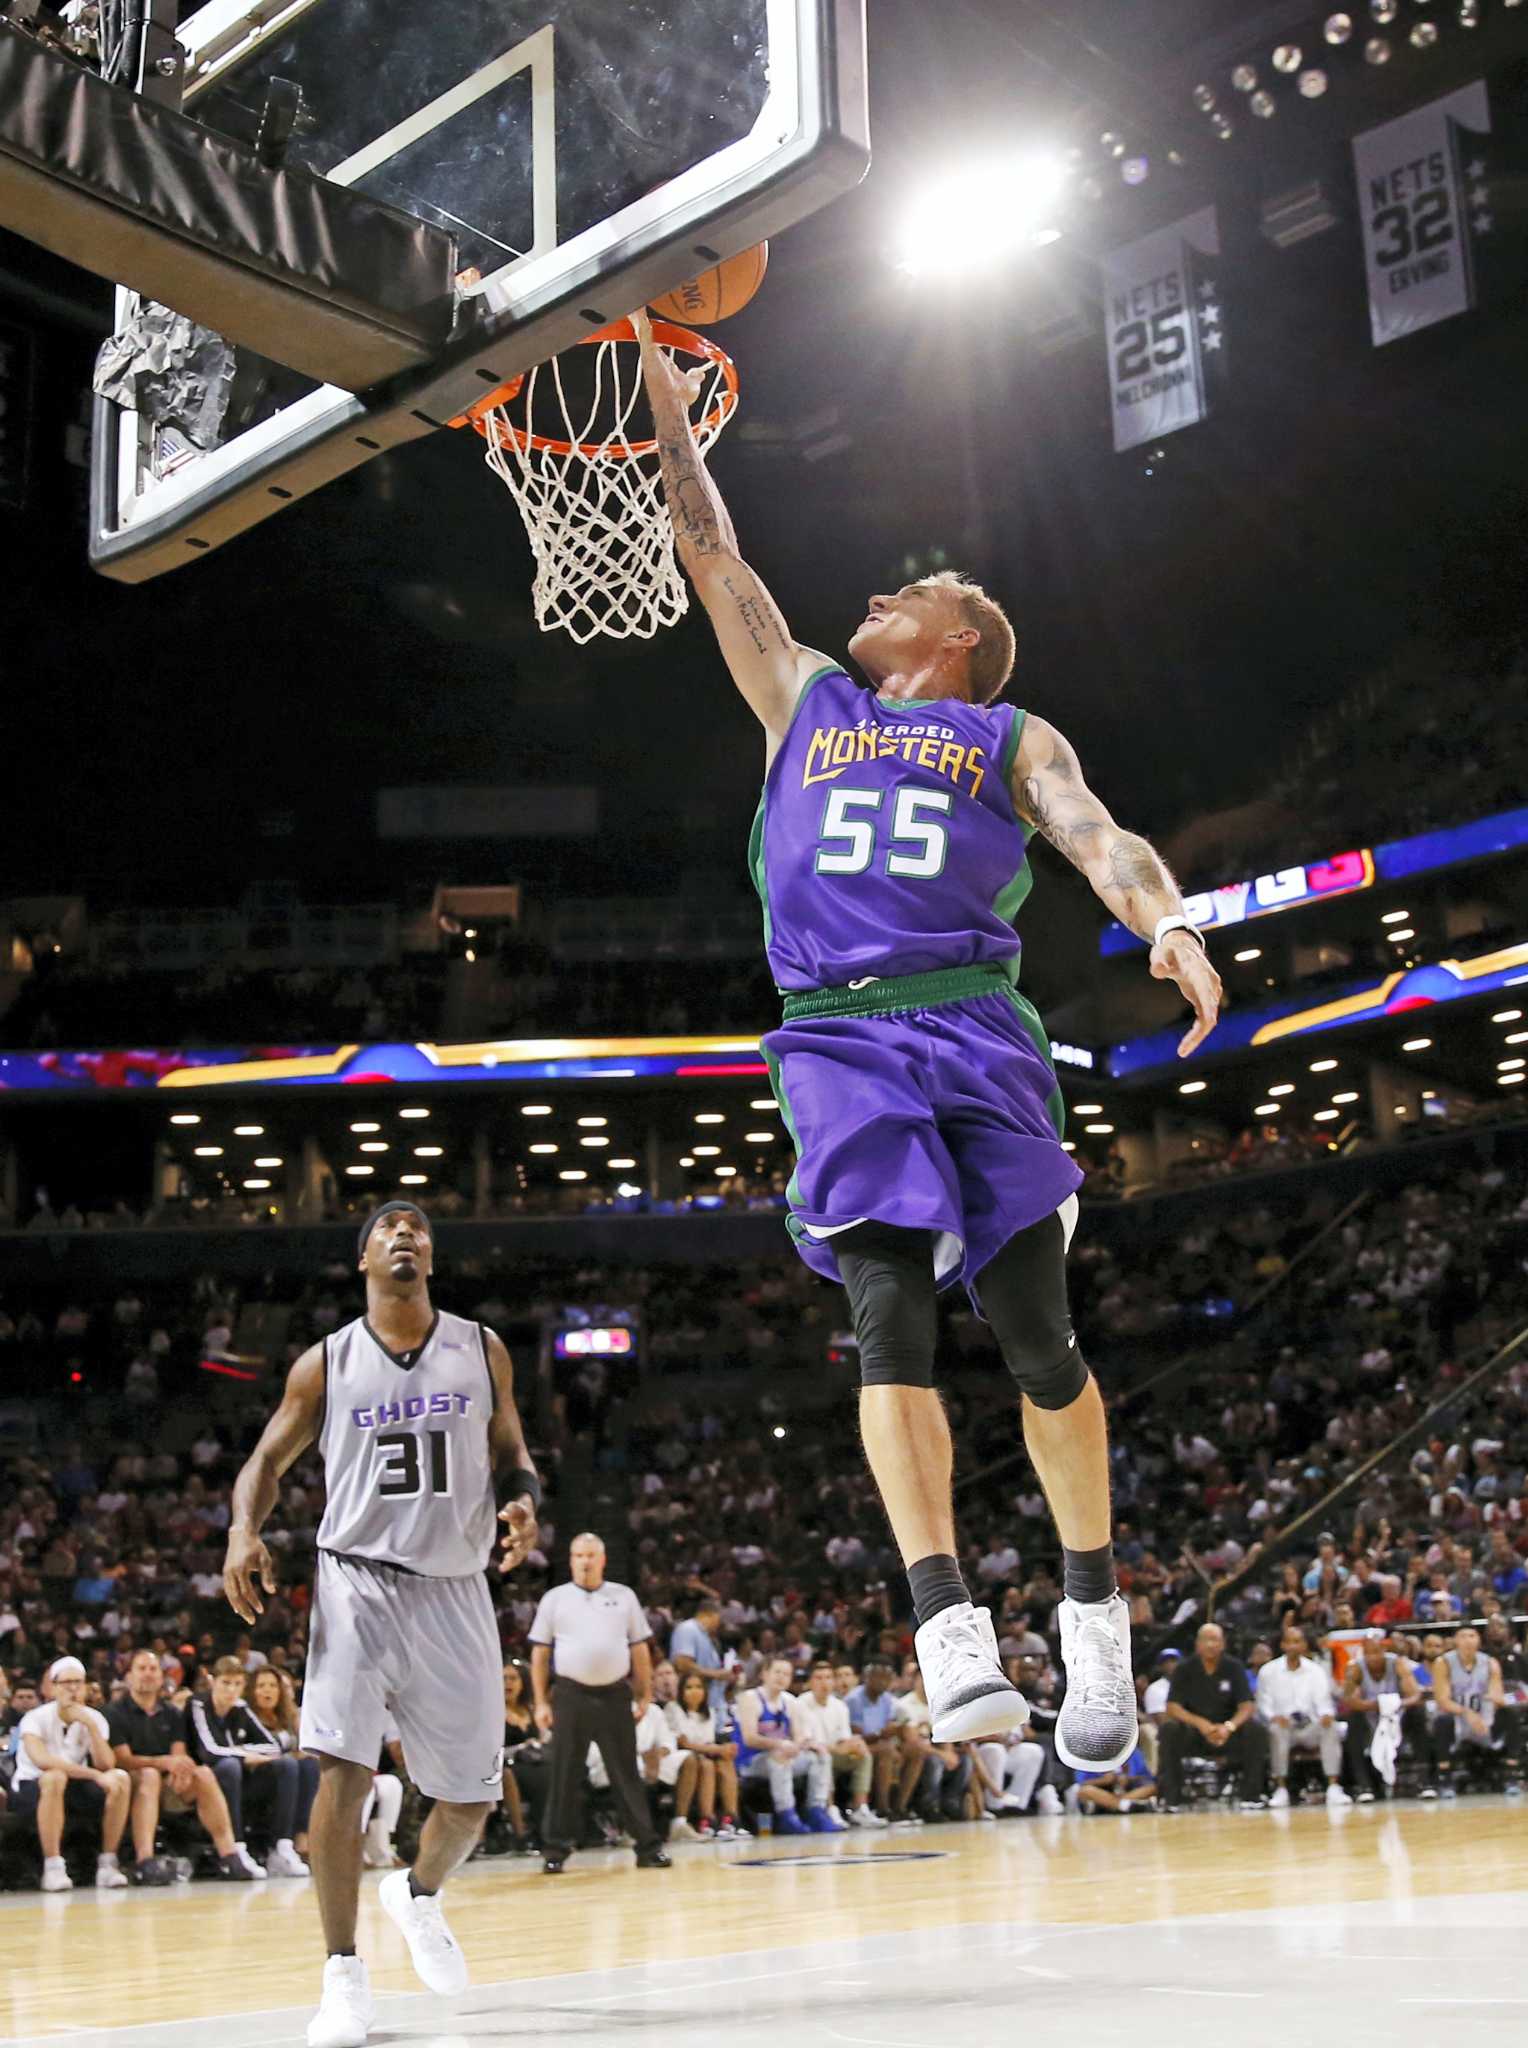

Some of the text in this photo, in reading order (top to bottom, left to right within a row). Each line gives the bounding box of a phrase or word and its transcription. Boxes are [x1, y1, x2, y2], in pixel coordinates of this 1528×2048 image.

[1370, 151, 1445, 208] NETS
[1372, 188, 1454, 267] 32
[1112, 271, 1180, 326] NETS
[1114, 304, 1186, 382] 25
[802, 727, 985, 799] MONSTERS
[814, 786, 953, 880] 55
[352, 1393, 472, 1429] GHOST
[376, 1430, 452, 1500] 31
